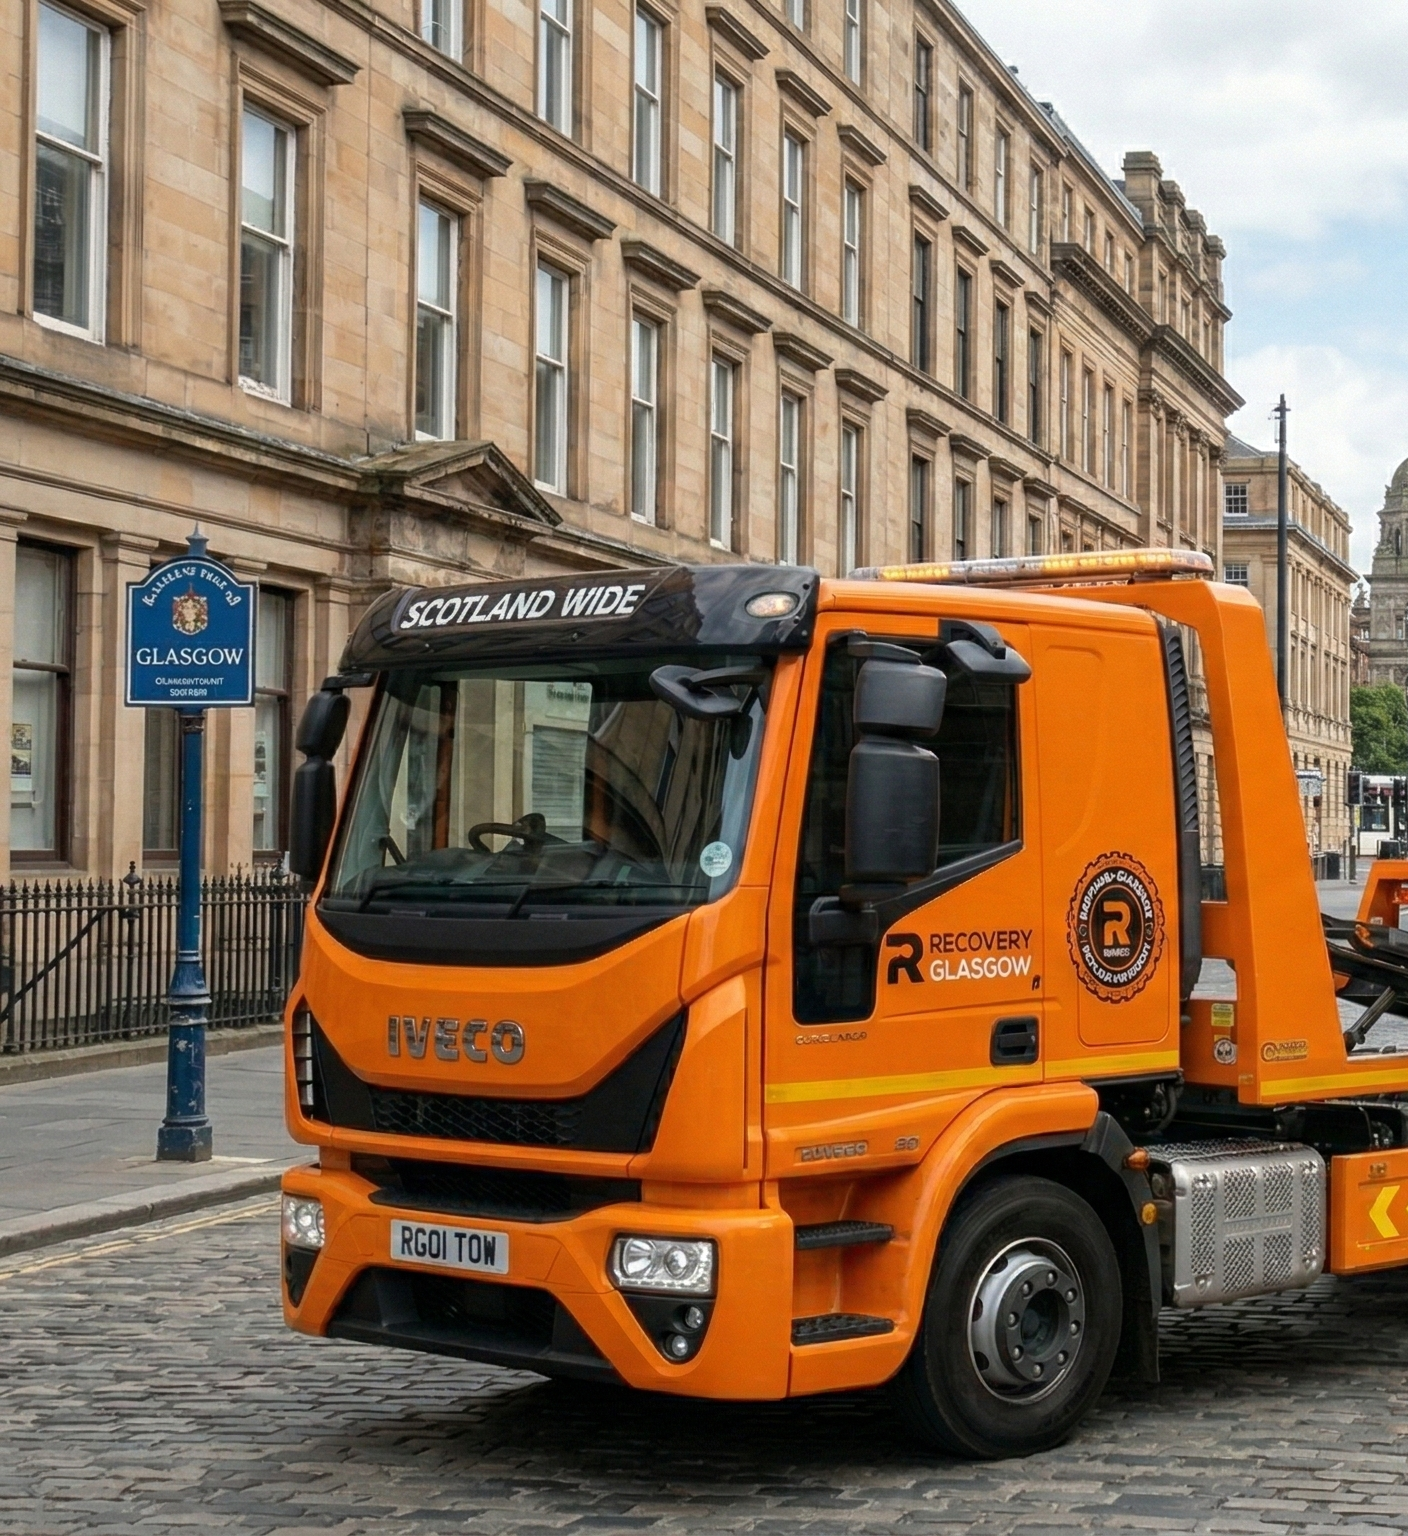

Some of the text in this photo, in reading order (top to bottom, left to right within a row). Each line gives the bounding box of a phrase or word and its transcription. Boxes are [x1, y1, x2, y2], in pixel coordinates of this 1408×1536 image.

[400, 584, 646, 629] SCOTLAND WIDE
[136, 647, 244, 666] GLASGOW
[930, 929, 1033, 954] RECOVERY
[930, 955, 1032, 982] GLASGOW
[388, 1015, 526, 1065] IVECO
[454, 1232, 496, 1266] TOW
